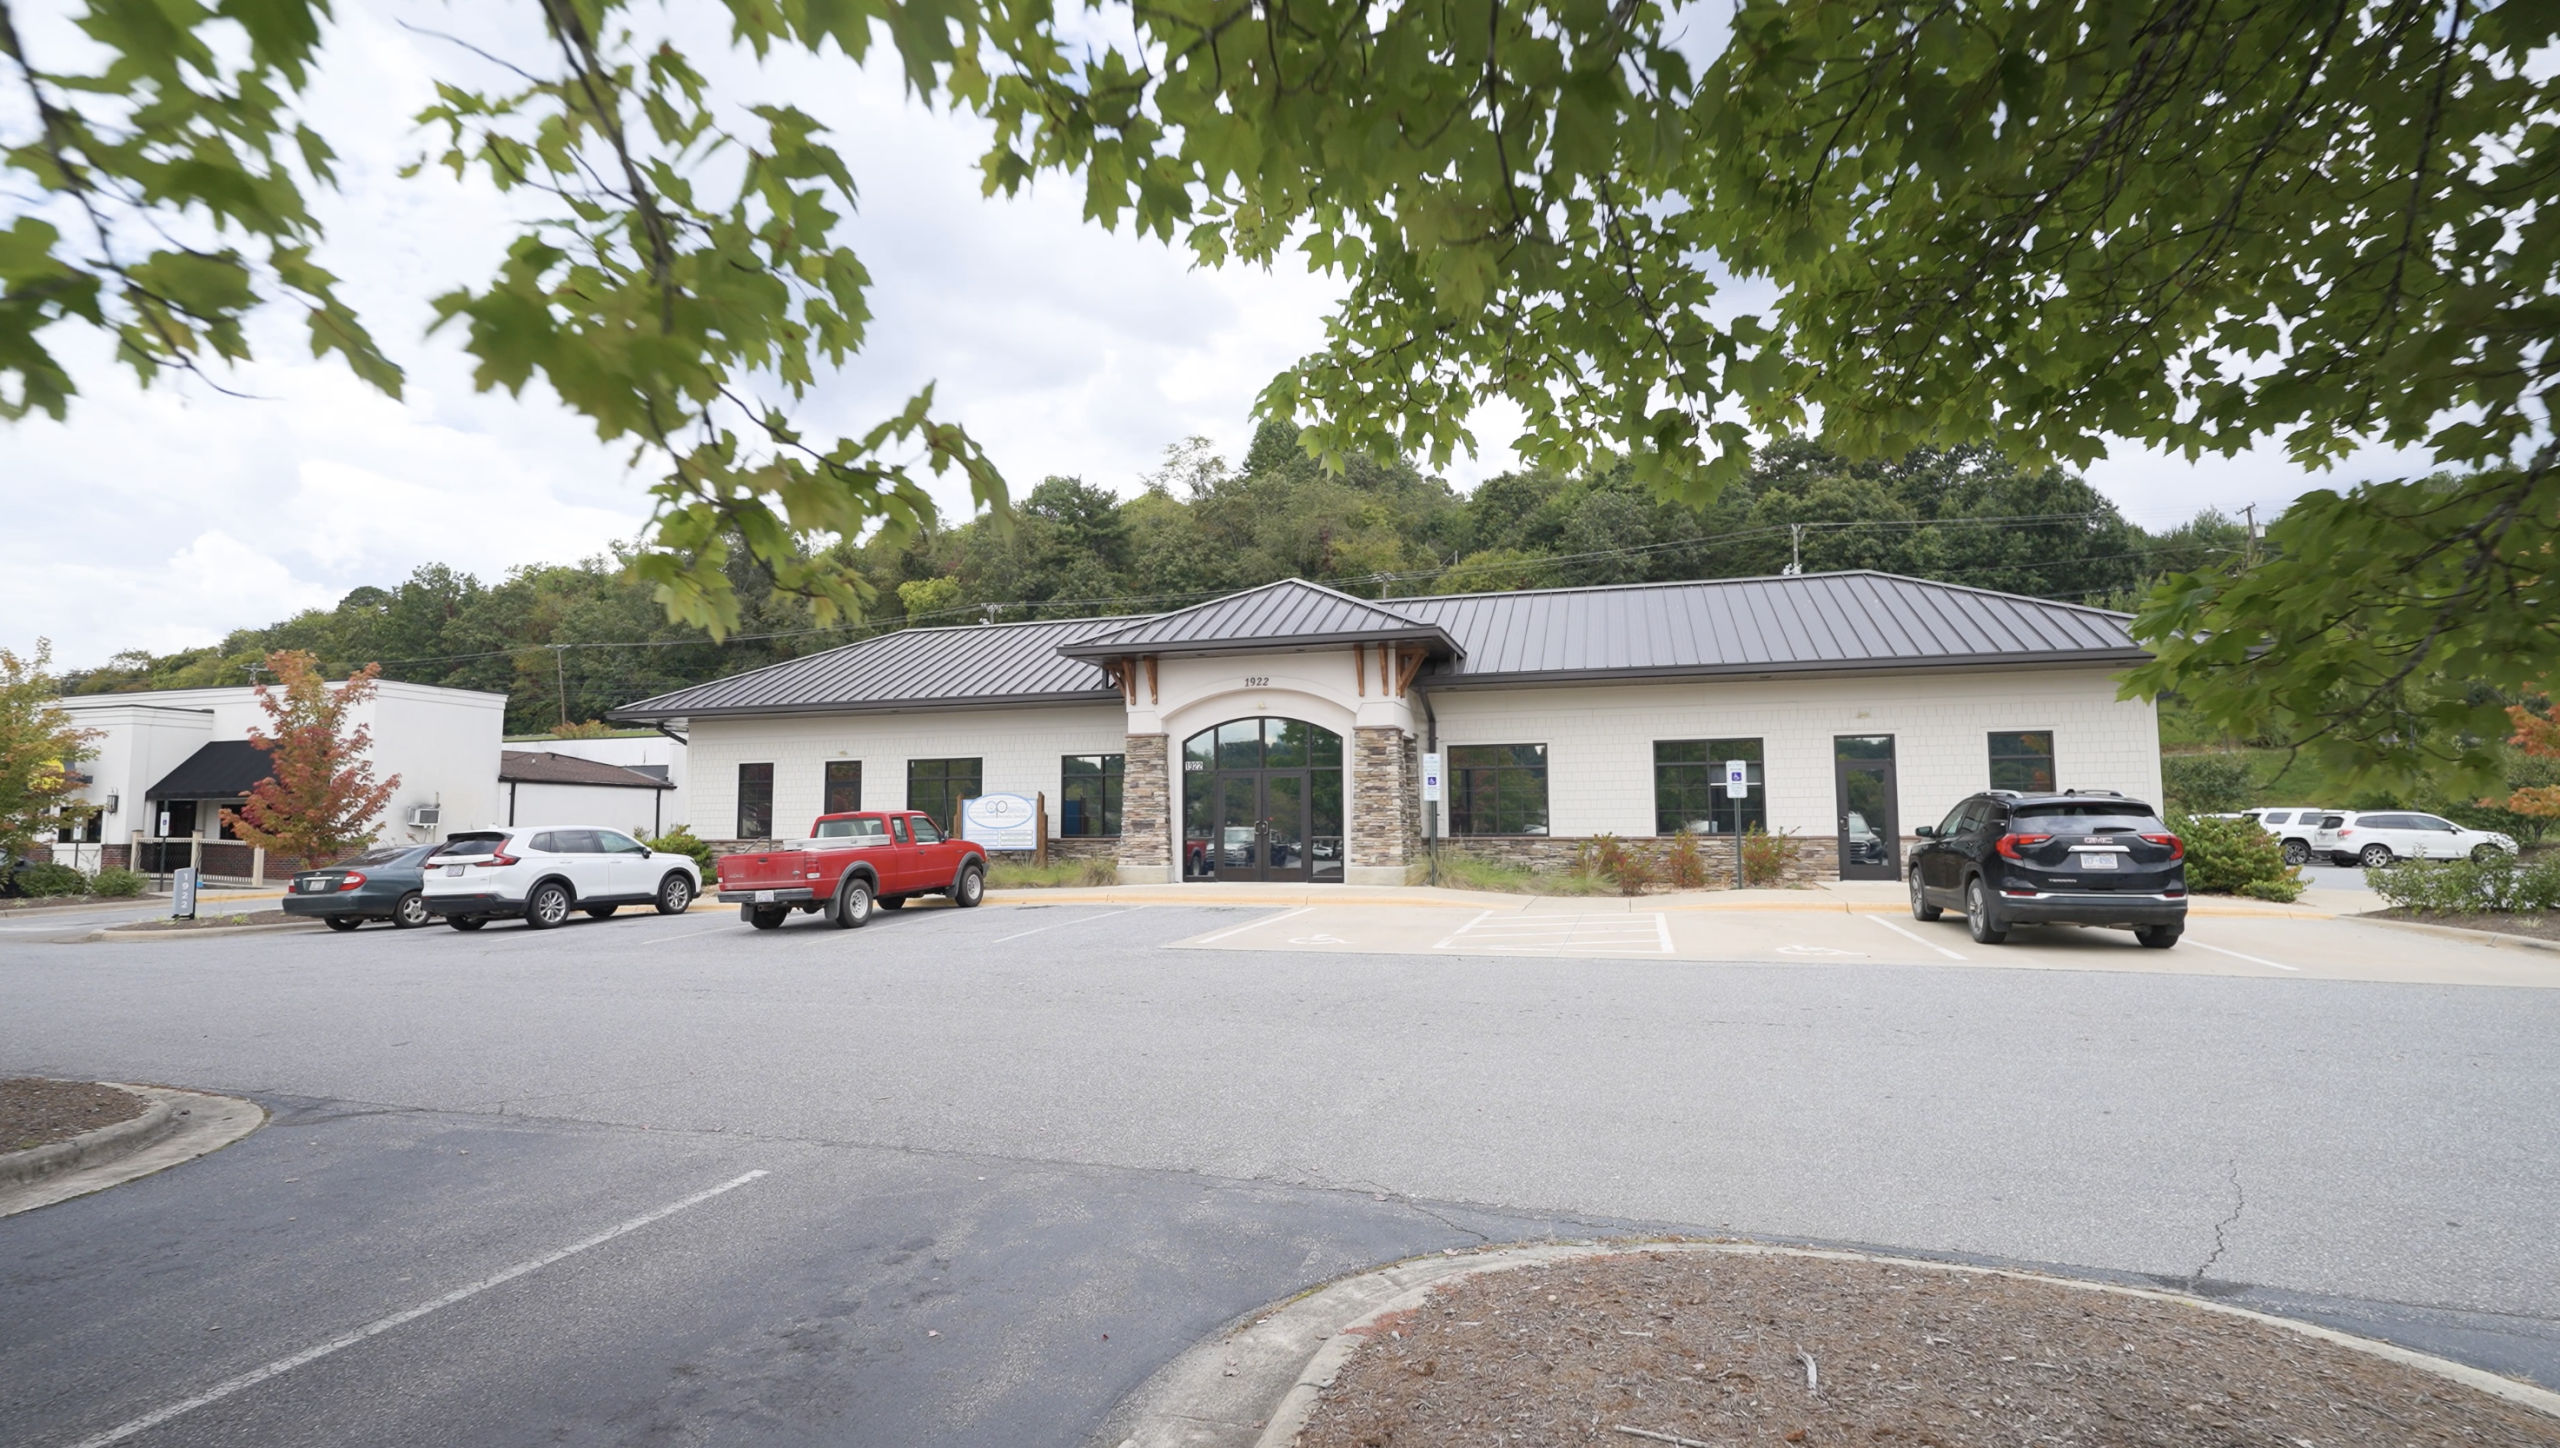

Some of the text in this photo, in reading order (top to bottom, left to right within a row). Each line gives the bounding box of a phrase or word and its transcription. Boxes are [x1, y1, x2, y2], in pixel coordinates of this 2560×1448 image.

[1245, 677, 1269, 687] 1922
[1186, 762, 1203, 771] 1922
[181, 873, 189, 909] 1922
